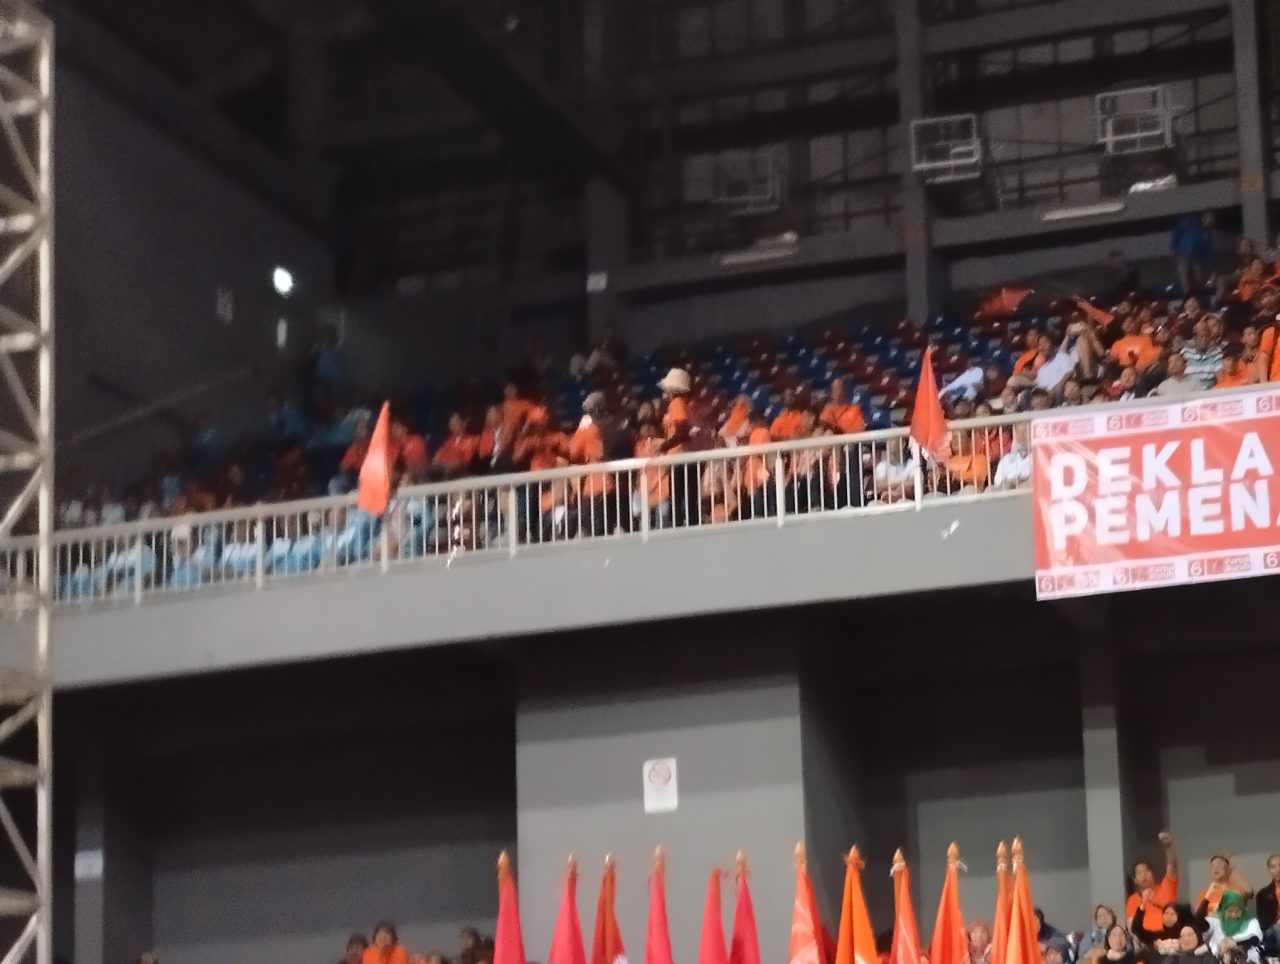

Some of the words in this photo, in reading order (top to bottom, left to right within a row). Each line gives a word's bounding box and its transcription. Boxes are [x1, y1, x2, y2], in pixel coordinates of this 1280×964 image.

[1258, 397, 1271, 411] 6
[1183, 407, 1196, 422] 6
[1109, 416, 1121, 430] 6
[1266, 553, 1278, 567] 6
[1191, 561, 1203, 576] 6
[1041, 577, 1052, 591] 6
